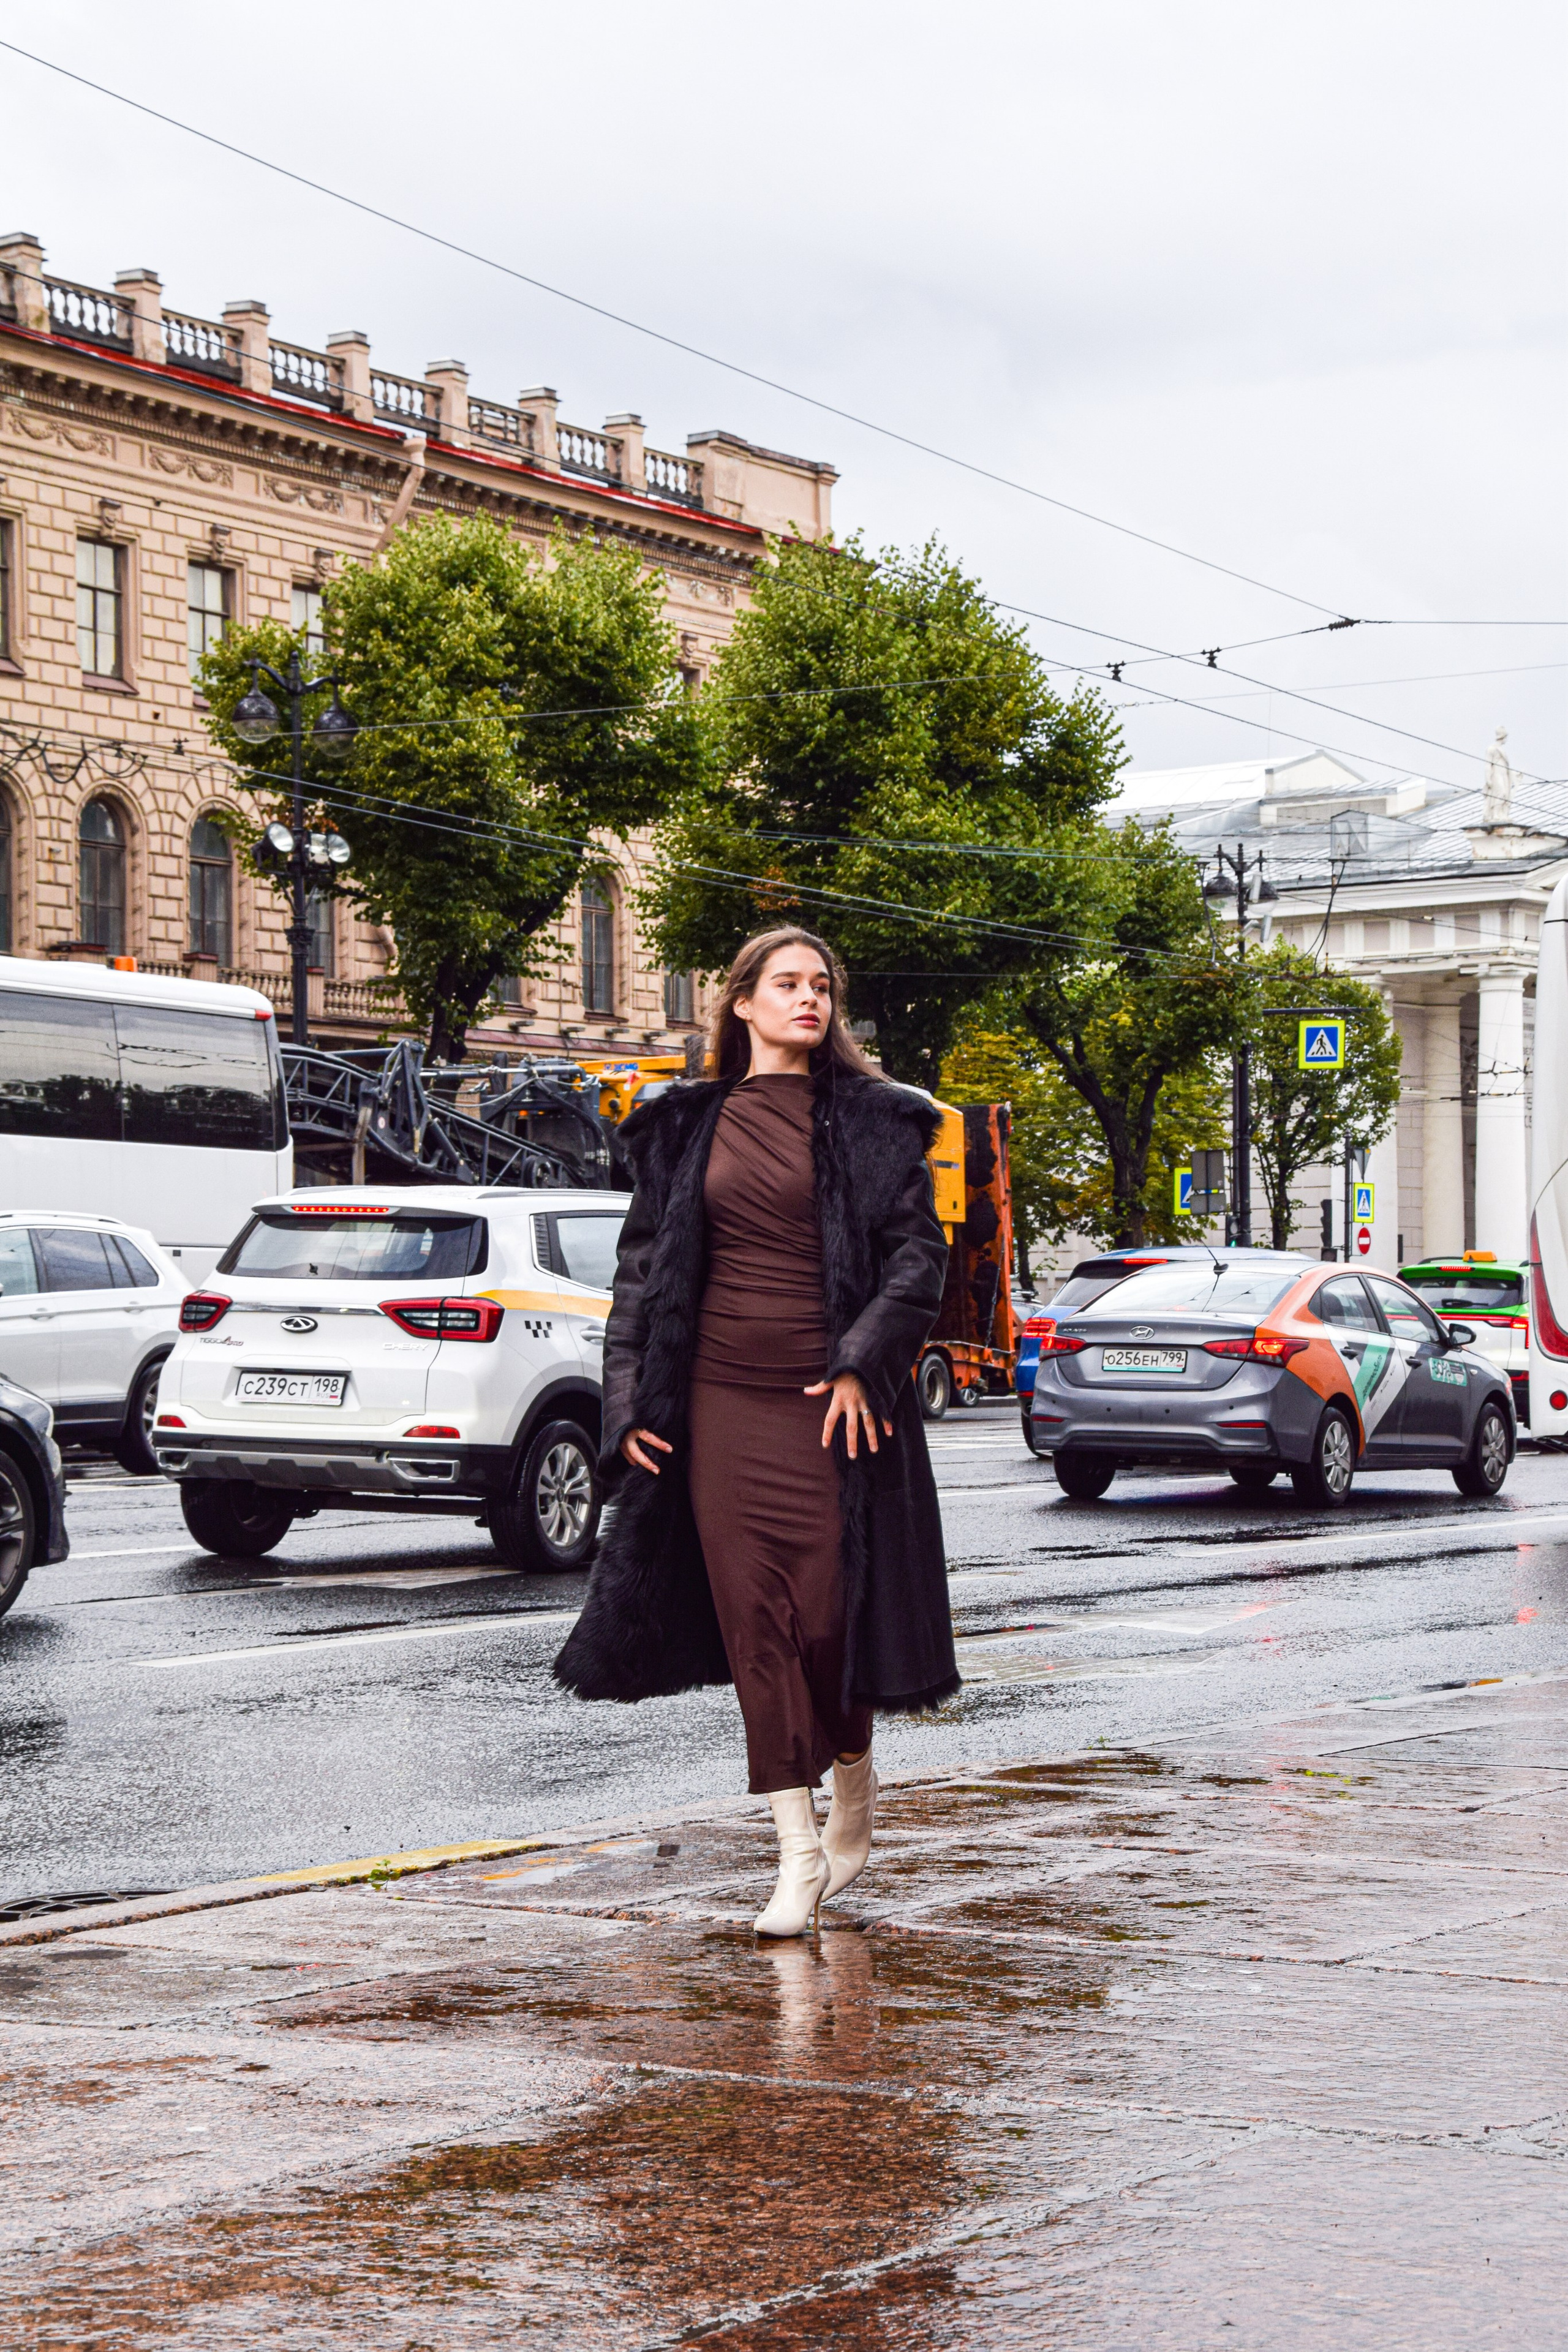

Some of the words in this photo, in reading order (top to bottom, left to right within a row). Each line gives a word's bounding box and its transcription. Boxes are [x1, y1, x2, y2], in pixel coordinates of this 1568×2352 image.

[382, 1343, 429, 1351] CHERY
[1163, 1351, 1182, 1363] 799
[314, 1378, 339, 1392] 198
